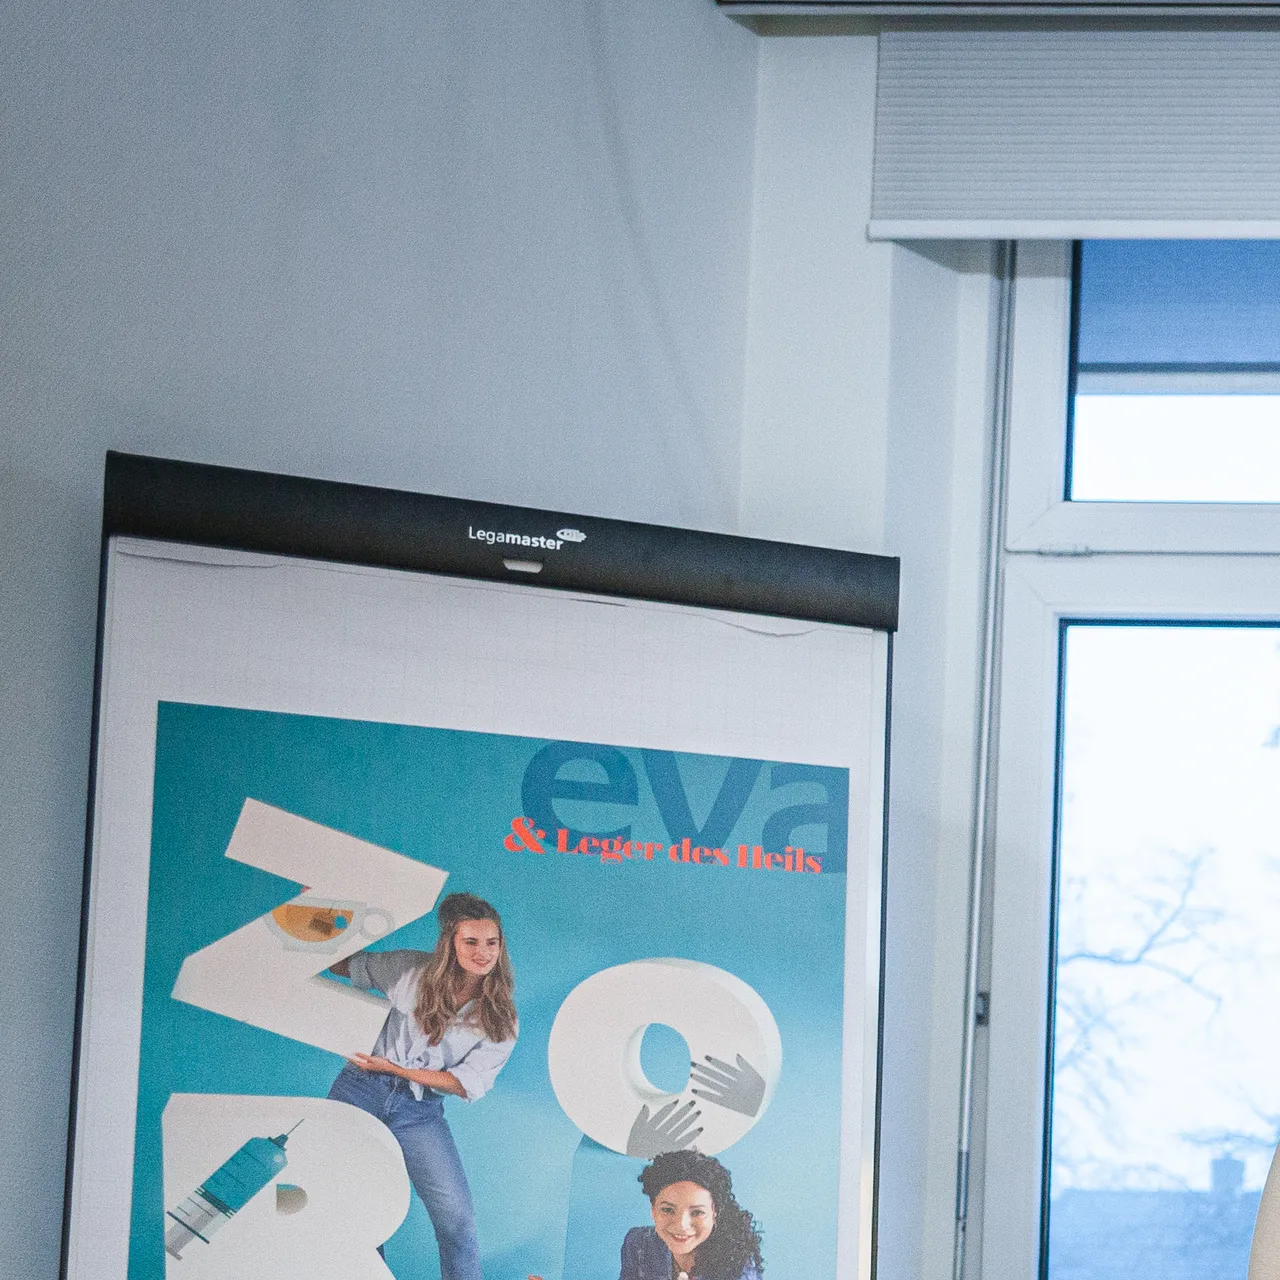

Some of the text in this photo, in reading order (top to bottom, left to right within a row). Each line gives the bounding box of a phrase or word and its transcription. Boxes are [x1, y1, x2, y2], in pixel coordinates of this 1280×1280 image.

[468, 525, 564, 551] Legamaster
[503, 816, 822, 874] & Leger des Heils
